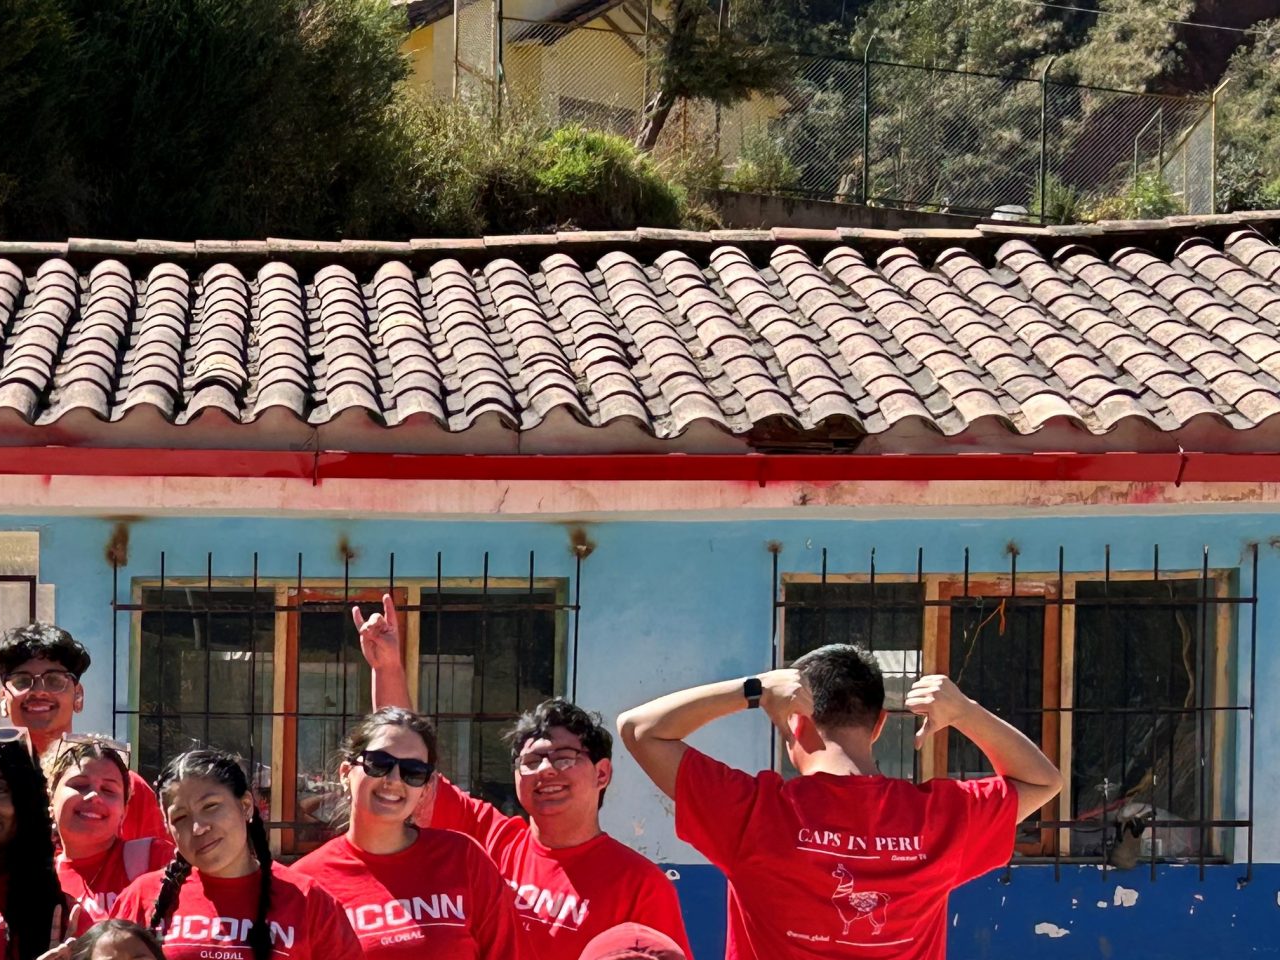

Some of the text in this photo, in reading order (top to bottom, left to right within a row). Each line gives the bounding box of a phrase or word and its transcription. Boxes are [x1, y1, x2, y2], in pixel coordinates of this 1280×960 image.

[798, 828, 923, 851] CAPS IN PERU
[380, 930, 424, 945] GLOBAL
[200, 950, 244, 960] GLOBAL
